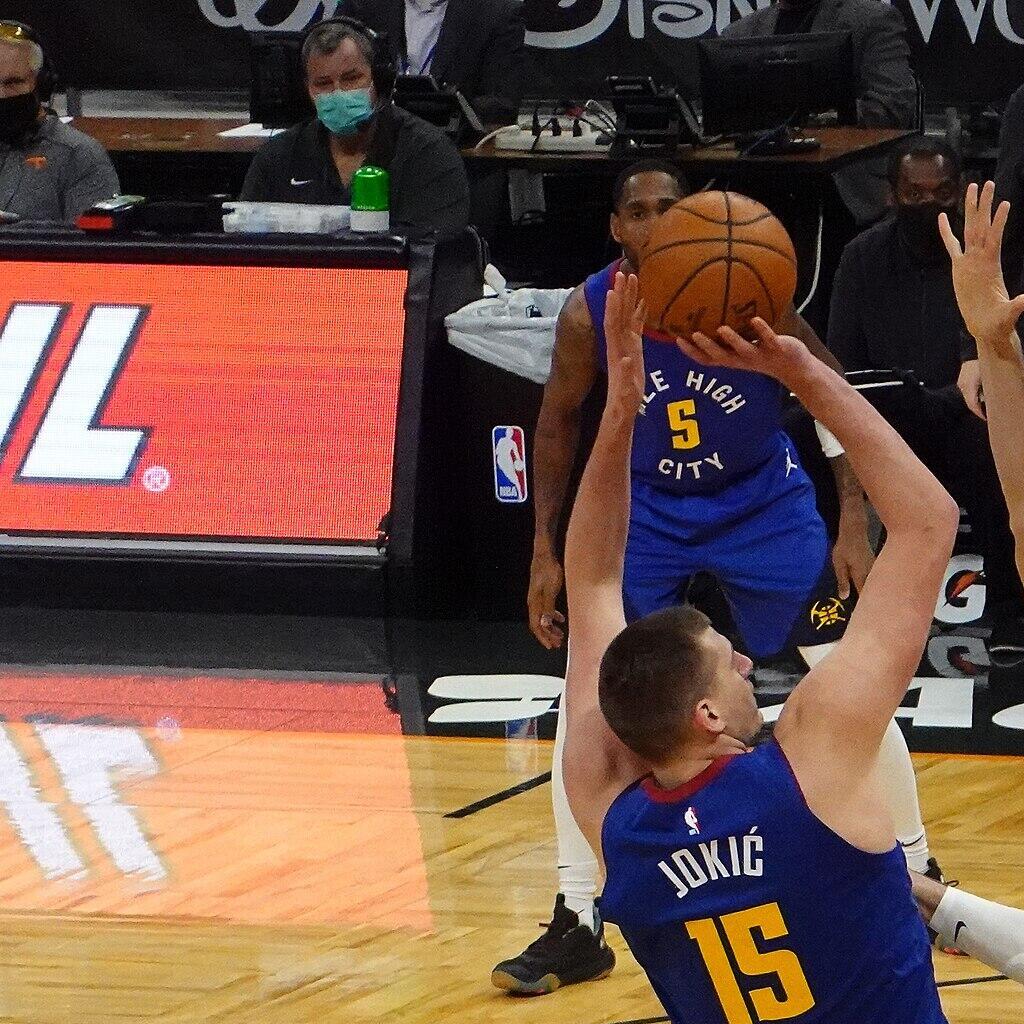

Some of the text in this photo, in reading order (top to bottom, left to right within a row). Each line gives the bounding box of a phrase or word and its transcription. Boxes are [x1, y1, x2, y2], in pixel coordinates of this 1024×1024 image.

[686, 370, 747, 415] HIGH
[666, 398, 701, 450] 5
[658, 452, 724, 481] CITY
[657, 826, 764, 899] JOKIĆ
